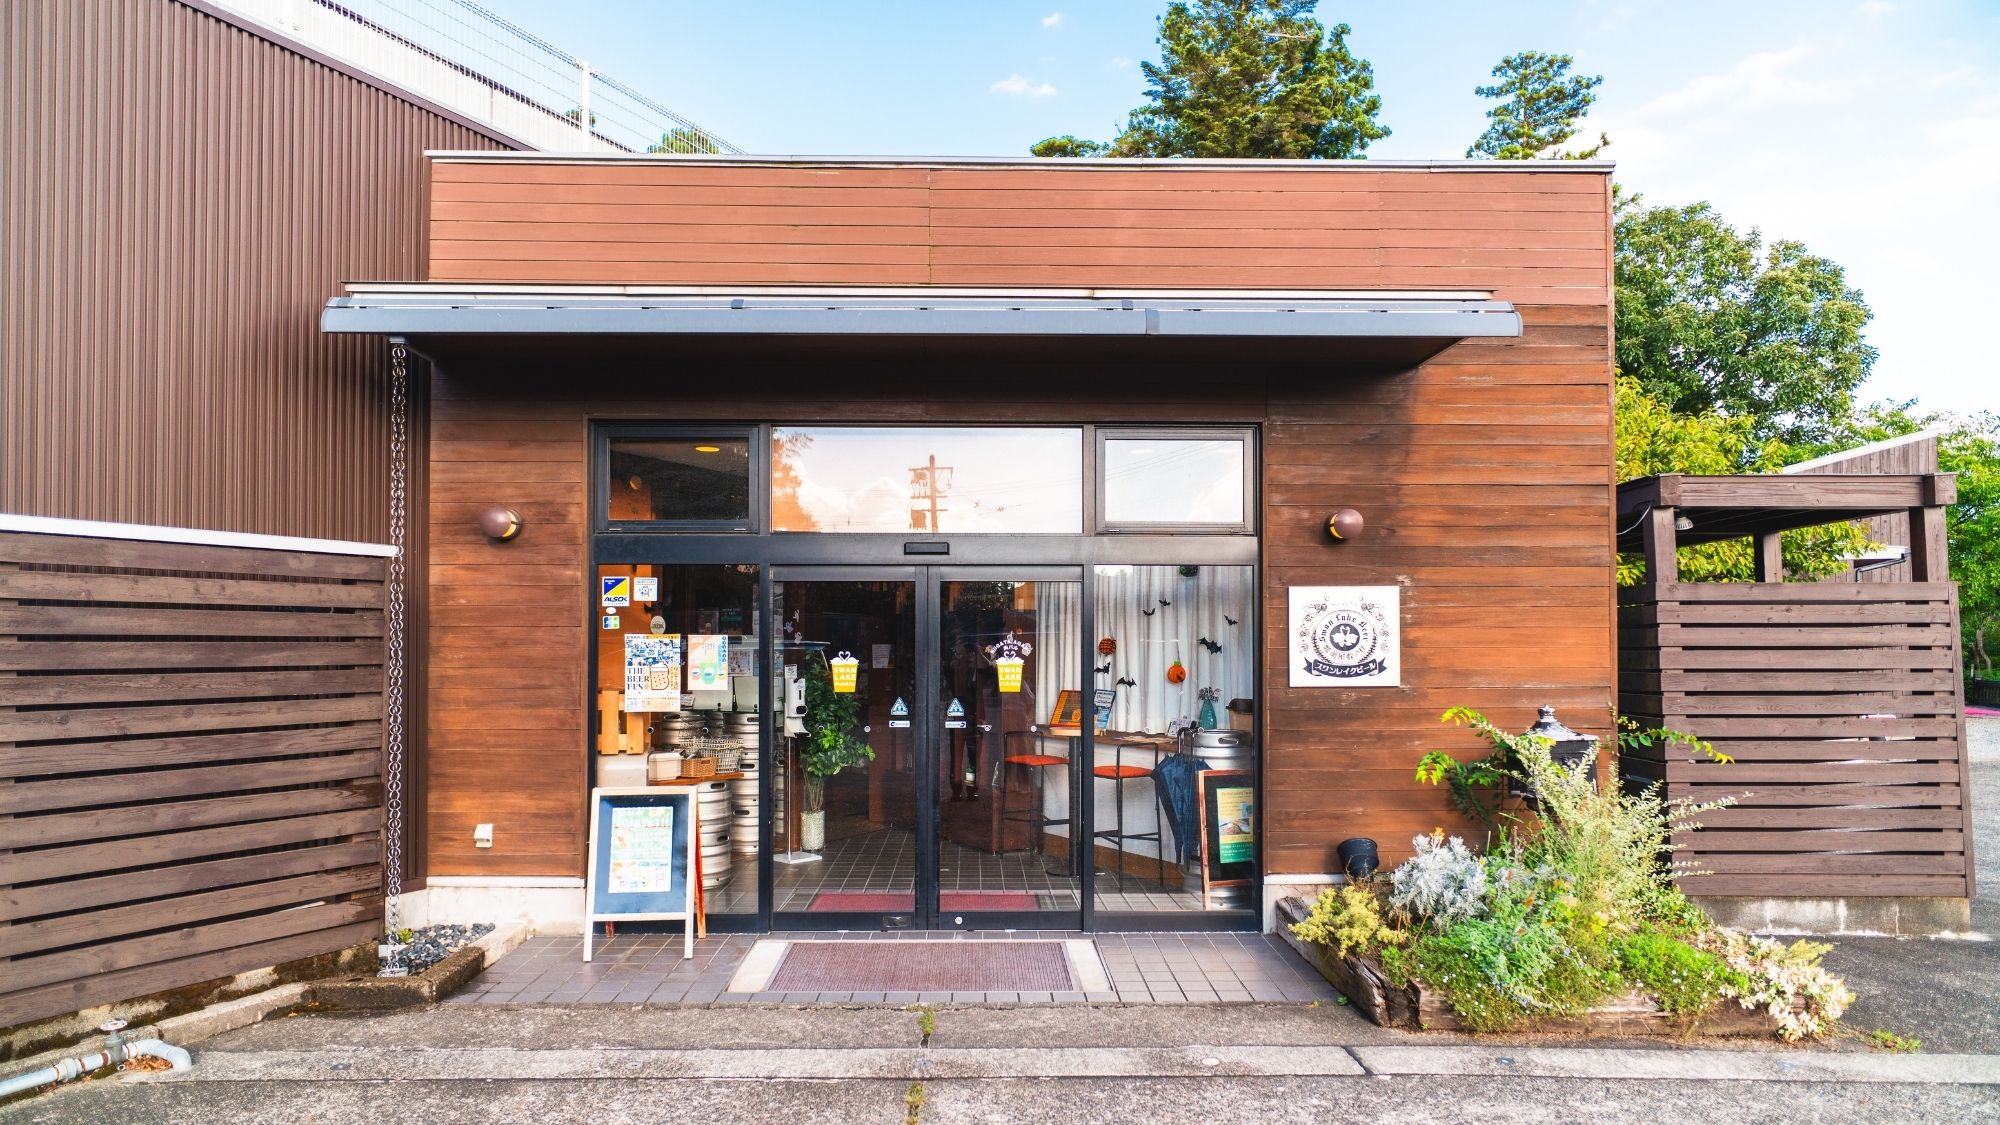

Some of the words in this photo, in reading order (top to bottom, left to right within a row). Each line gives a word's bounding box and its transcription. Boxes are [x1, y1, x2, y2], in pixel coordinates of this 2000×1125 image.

[1319, 620, 1334, 642] Swan
[1336, 613, 1357, 623] Lake
[1358, 621, 1368, 641] Beer
[1314, 662, 1376, 675] スワンレイクビール
